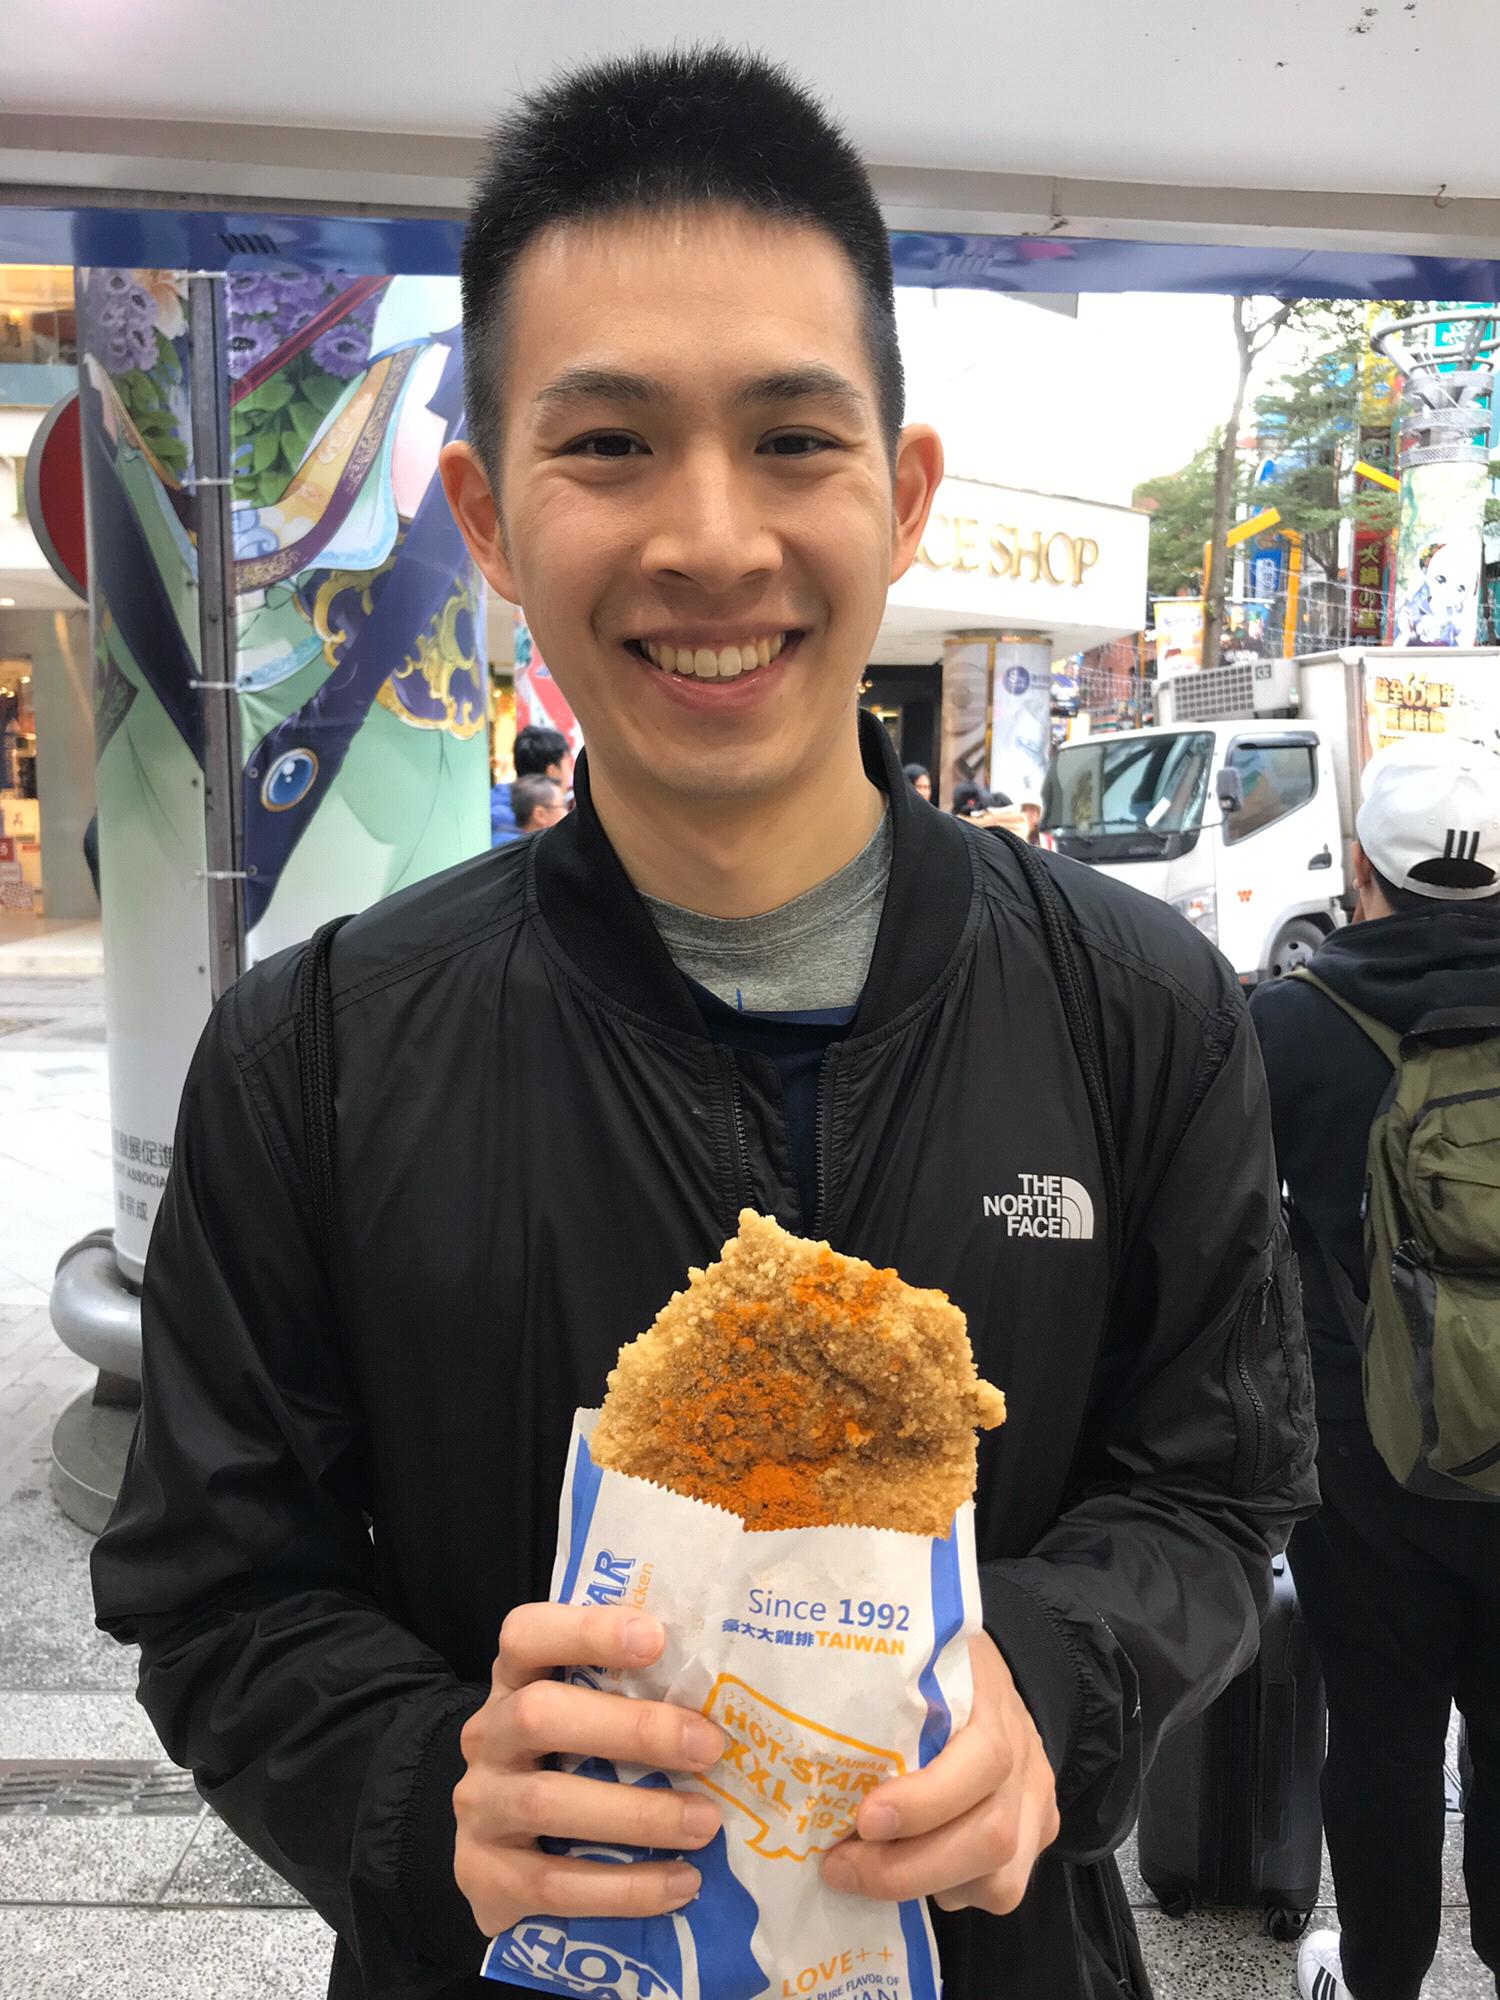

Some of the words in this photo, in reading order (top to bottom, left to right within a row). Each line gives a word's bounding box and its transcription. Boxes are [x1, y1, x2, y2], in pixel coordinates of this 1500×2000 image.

[912, 513, 979, 575] CE
[986, 522, 1100, 588] SHOP
[1017, 1173, 1061, 1196] THE
[982, 1193, 1061, 1217] NORTH
[1006, 1215, 1061, 1239] FACE
[582, 1549, 636, 1606] AR
[748, 1588, 827, 1622] Since
[837, 1598, 911, 1632] 1992
[815, 1630, 906, 1656] TAIWAN
[722, 1738, 793, 1813] XXL
[518, 1926, 669, 1999] HOT
[846, 1973, 883, 1992] FLAVOR
[886, 1975, 900, 1986] OF
